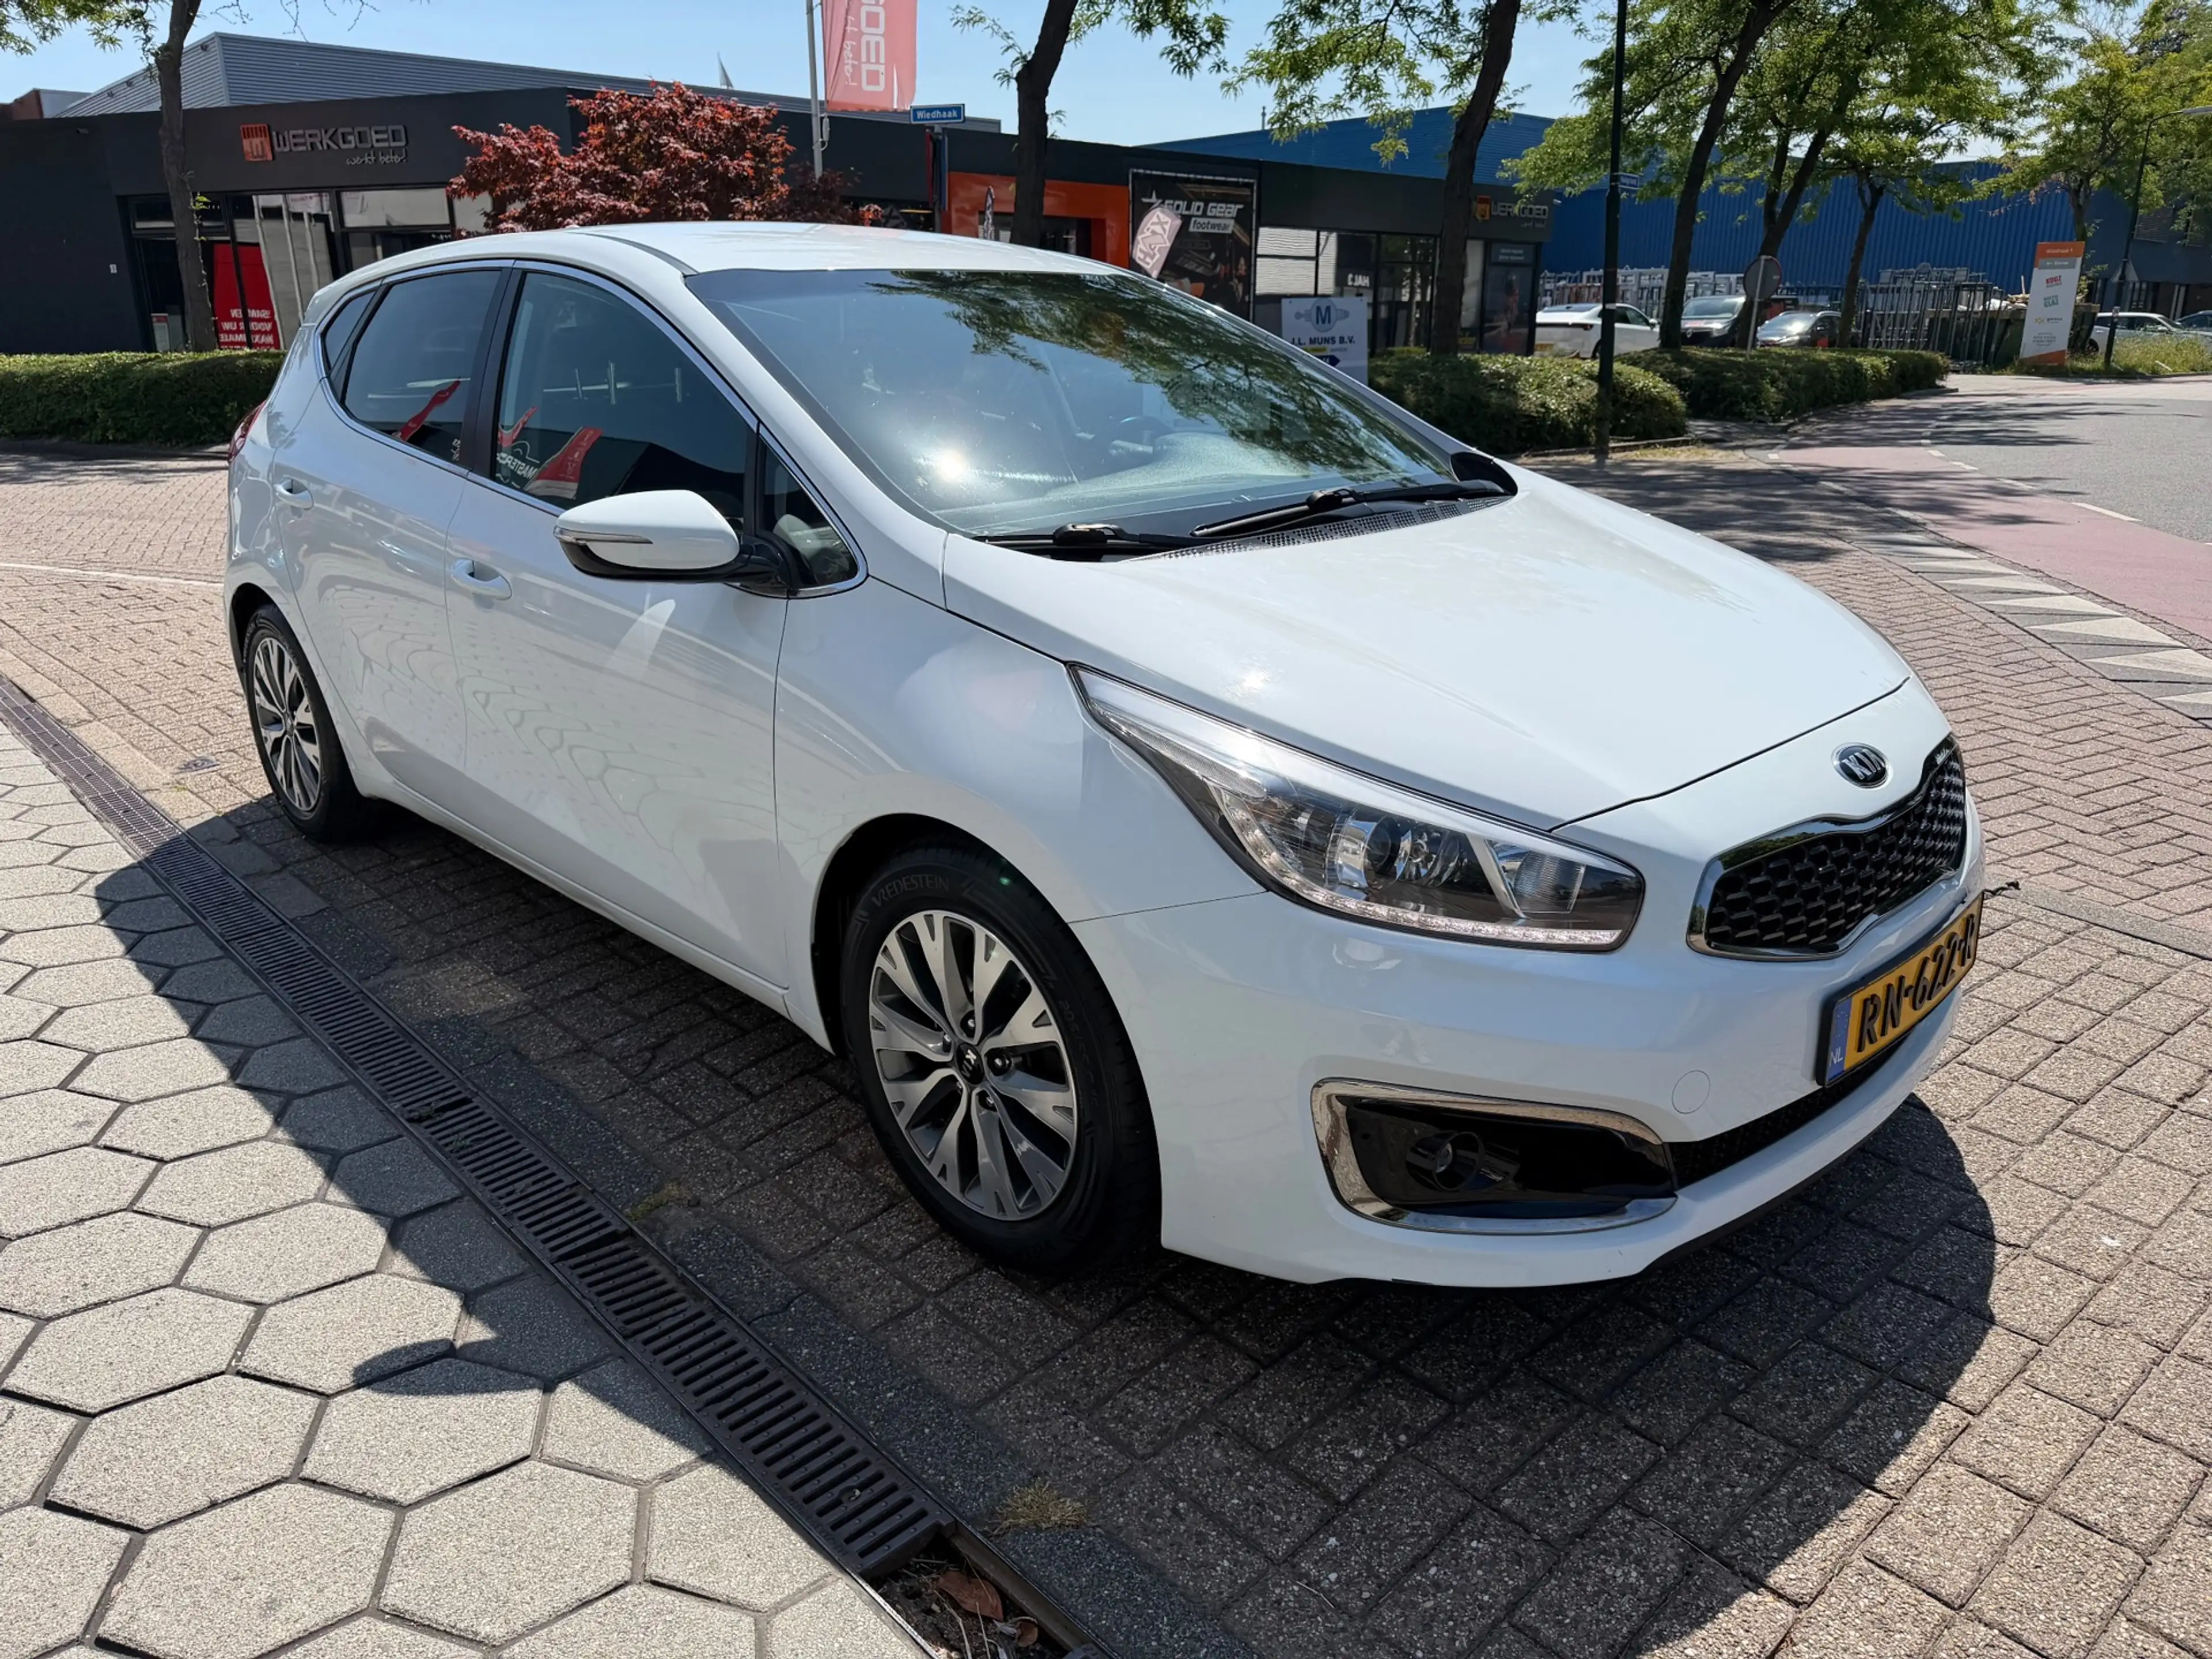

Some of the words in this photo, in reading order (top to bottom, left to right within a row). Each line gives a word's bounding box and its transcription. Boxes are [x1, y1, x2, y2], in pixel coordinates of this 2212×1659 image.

[861, 0, 886, 92] OED
[916, 109, 959, 120] Wiedhaak
[271, 124, 407, 152] WERKGOED
[1163, 199, 1205, 215] SOLID
[1491, 202, 1548, 219] WERGOED
[1192, 219, 1232, 230] footwear
[1316, 305, 1331, 324] M
[1309, 336, 1336, 346] MUNS
[1339, 335, 1355, 345] B.V.
[1842, 748, 1886, 780] KIA
[870, 874, 950, 907] VREDESTEIN
[1856, 913, 1976, 1053] RN-622-R
[1829, 1047, 1844, 1067] NL
